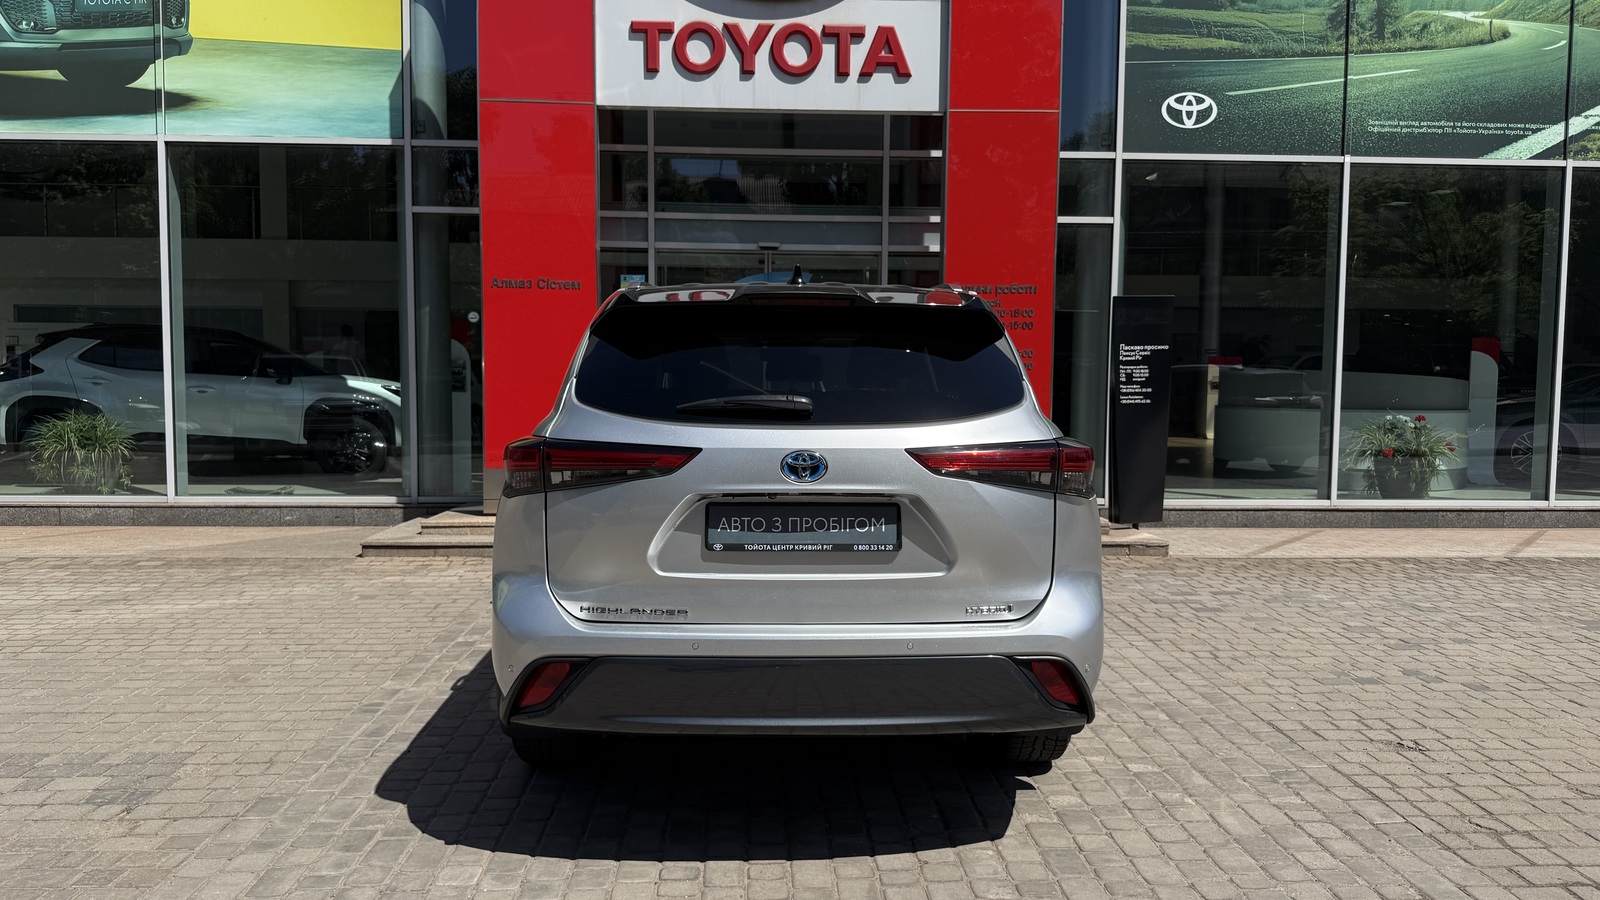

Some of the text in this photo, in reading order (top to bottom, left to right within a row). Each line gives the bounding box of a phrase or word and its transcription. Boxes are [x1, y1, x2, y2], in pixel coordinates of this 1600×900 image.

[630, 20, 913, 78] TOYOTA
[1462, 120, 1476, 128] його
[1476, 121, 1508, 129] складових
[491, 277, 581, 291] Алмаз Сістем
[995, 283, 1038, 297] роботи
[717, 516, 886, 533] АВТО З ПРОБІГОМ
[744, 543, 771, 551] ТОЙОТА
[772, 544, 794, 552] ЦЕНТР
[795, 543, 822, 551] КРИВИЙ
[580, 605, 689, 616] HIGHLANDER
